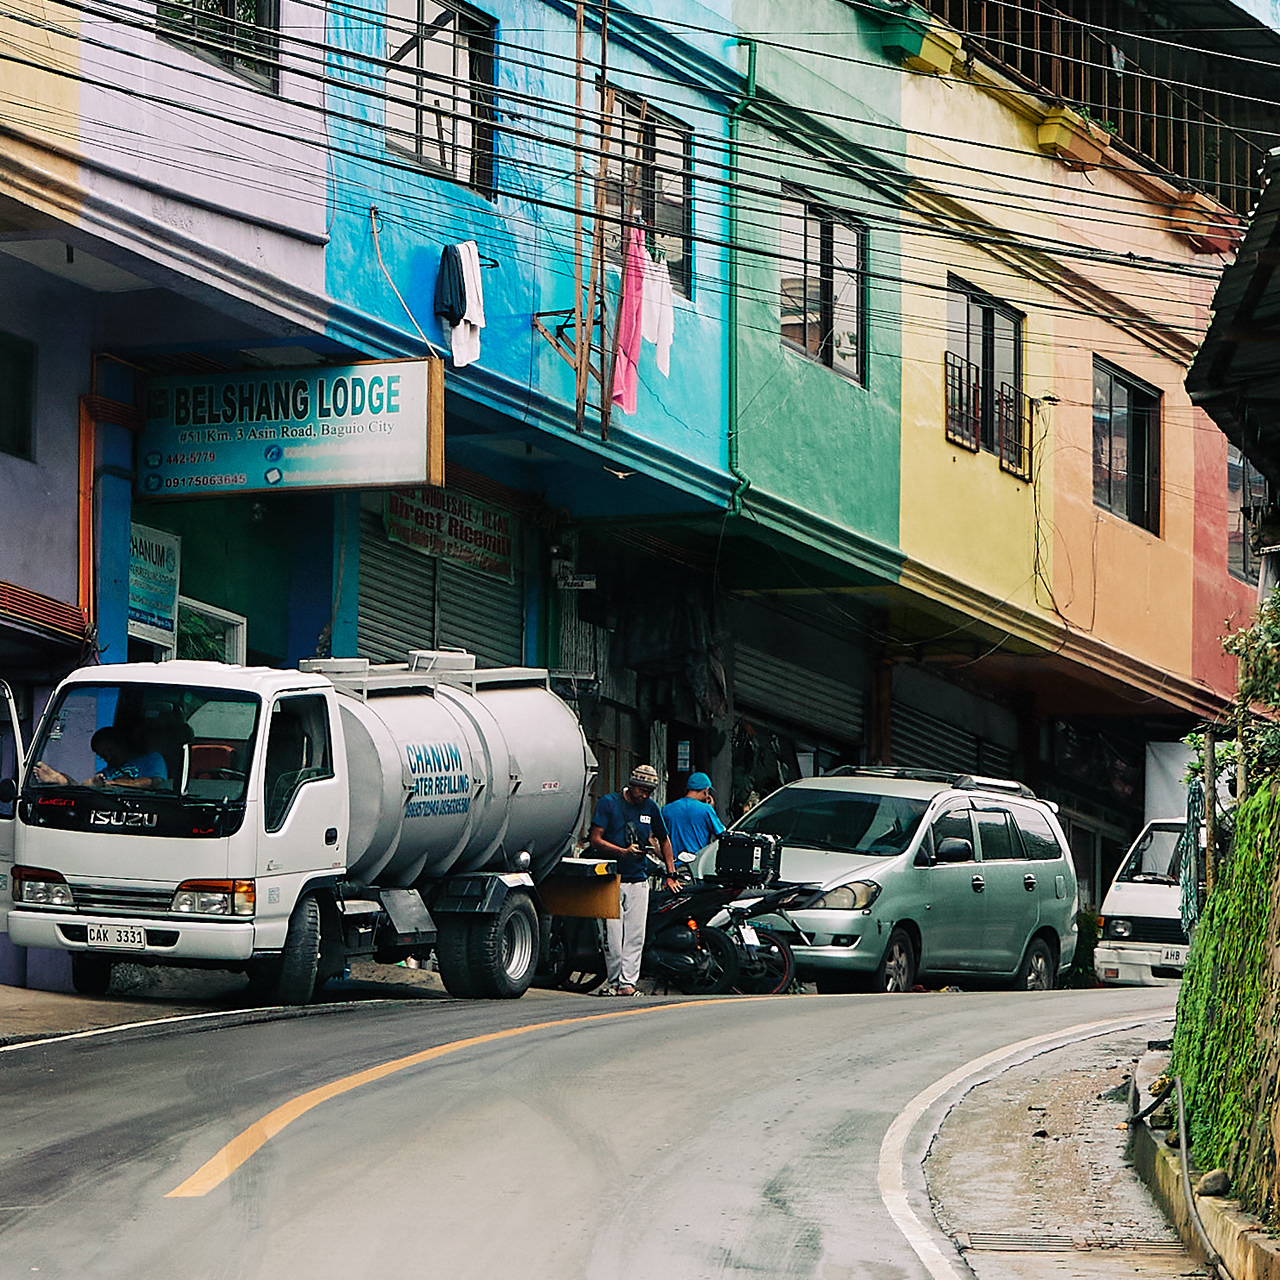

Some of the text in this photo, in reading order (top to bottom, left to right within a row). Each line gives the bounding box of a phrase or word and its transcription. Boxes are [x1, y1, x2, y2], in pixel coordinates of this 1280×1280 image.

[173, 374, 402, 427] BELSHANG LODGE
[179, 431, 202, 444] #51
[206, 429, 232, 442] Km.
[236, 427, 244, 441] 3
[247, 426, 276, 440] Asin
[321, 422, 364, 438] Baguio
[368, 420, 396, 435] City
[166, 451, 216, 465] 442-5779
[388, 493, 443, 533] Direct
[448, 516, 512, 557] Ricemill
[405, 742, 463, 775] CHANUM
[412, 774, 470, 797] ATER REFILLING
[89, 809, 159, 828] ISUZU
[88, 927, 144, 945] CAK 3331
